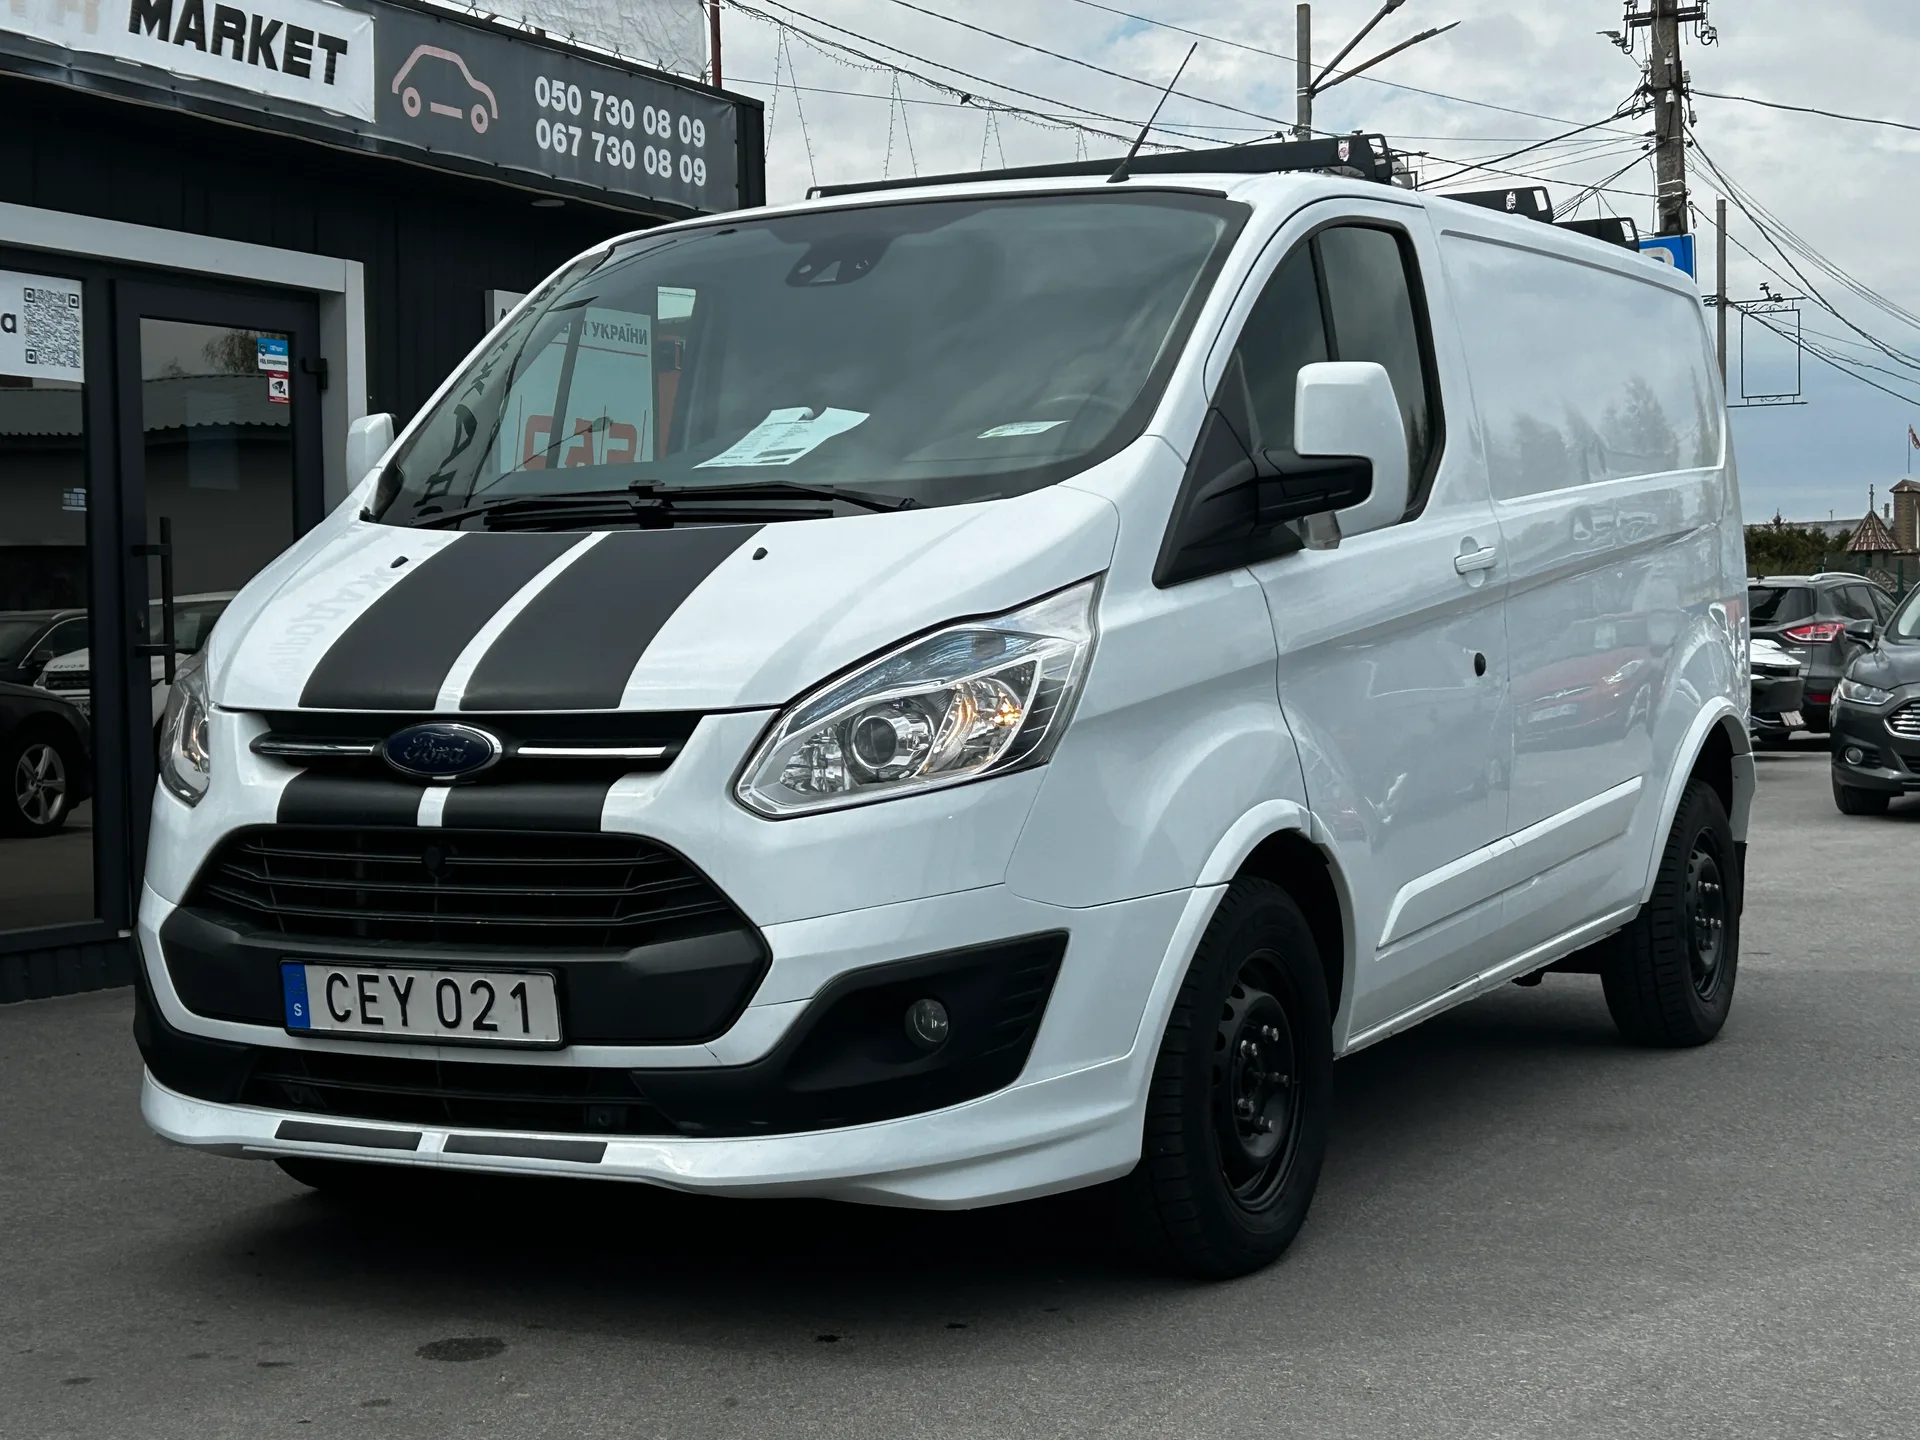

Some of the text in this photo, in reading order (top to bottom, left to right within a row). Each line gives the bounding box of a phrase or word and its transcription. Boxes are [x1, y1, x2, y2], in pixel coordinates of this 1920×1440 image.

[128, 0, 348, 85] MARKET
[535, 75, 706, 148] 050 730 08 09
[536, 118, 707, 187] 067 730 08 09
[591, 321, 648, 346] УКРАЇНИ
[403, 731, 470, 764] Ford
[293, 1003, 302, 1017] S
[325, 972, 530, 1034] CEY 021
